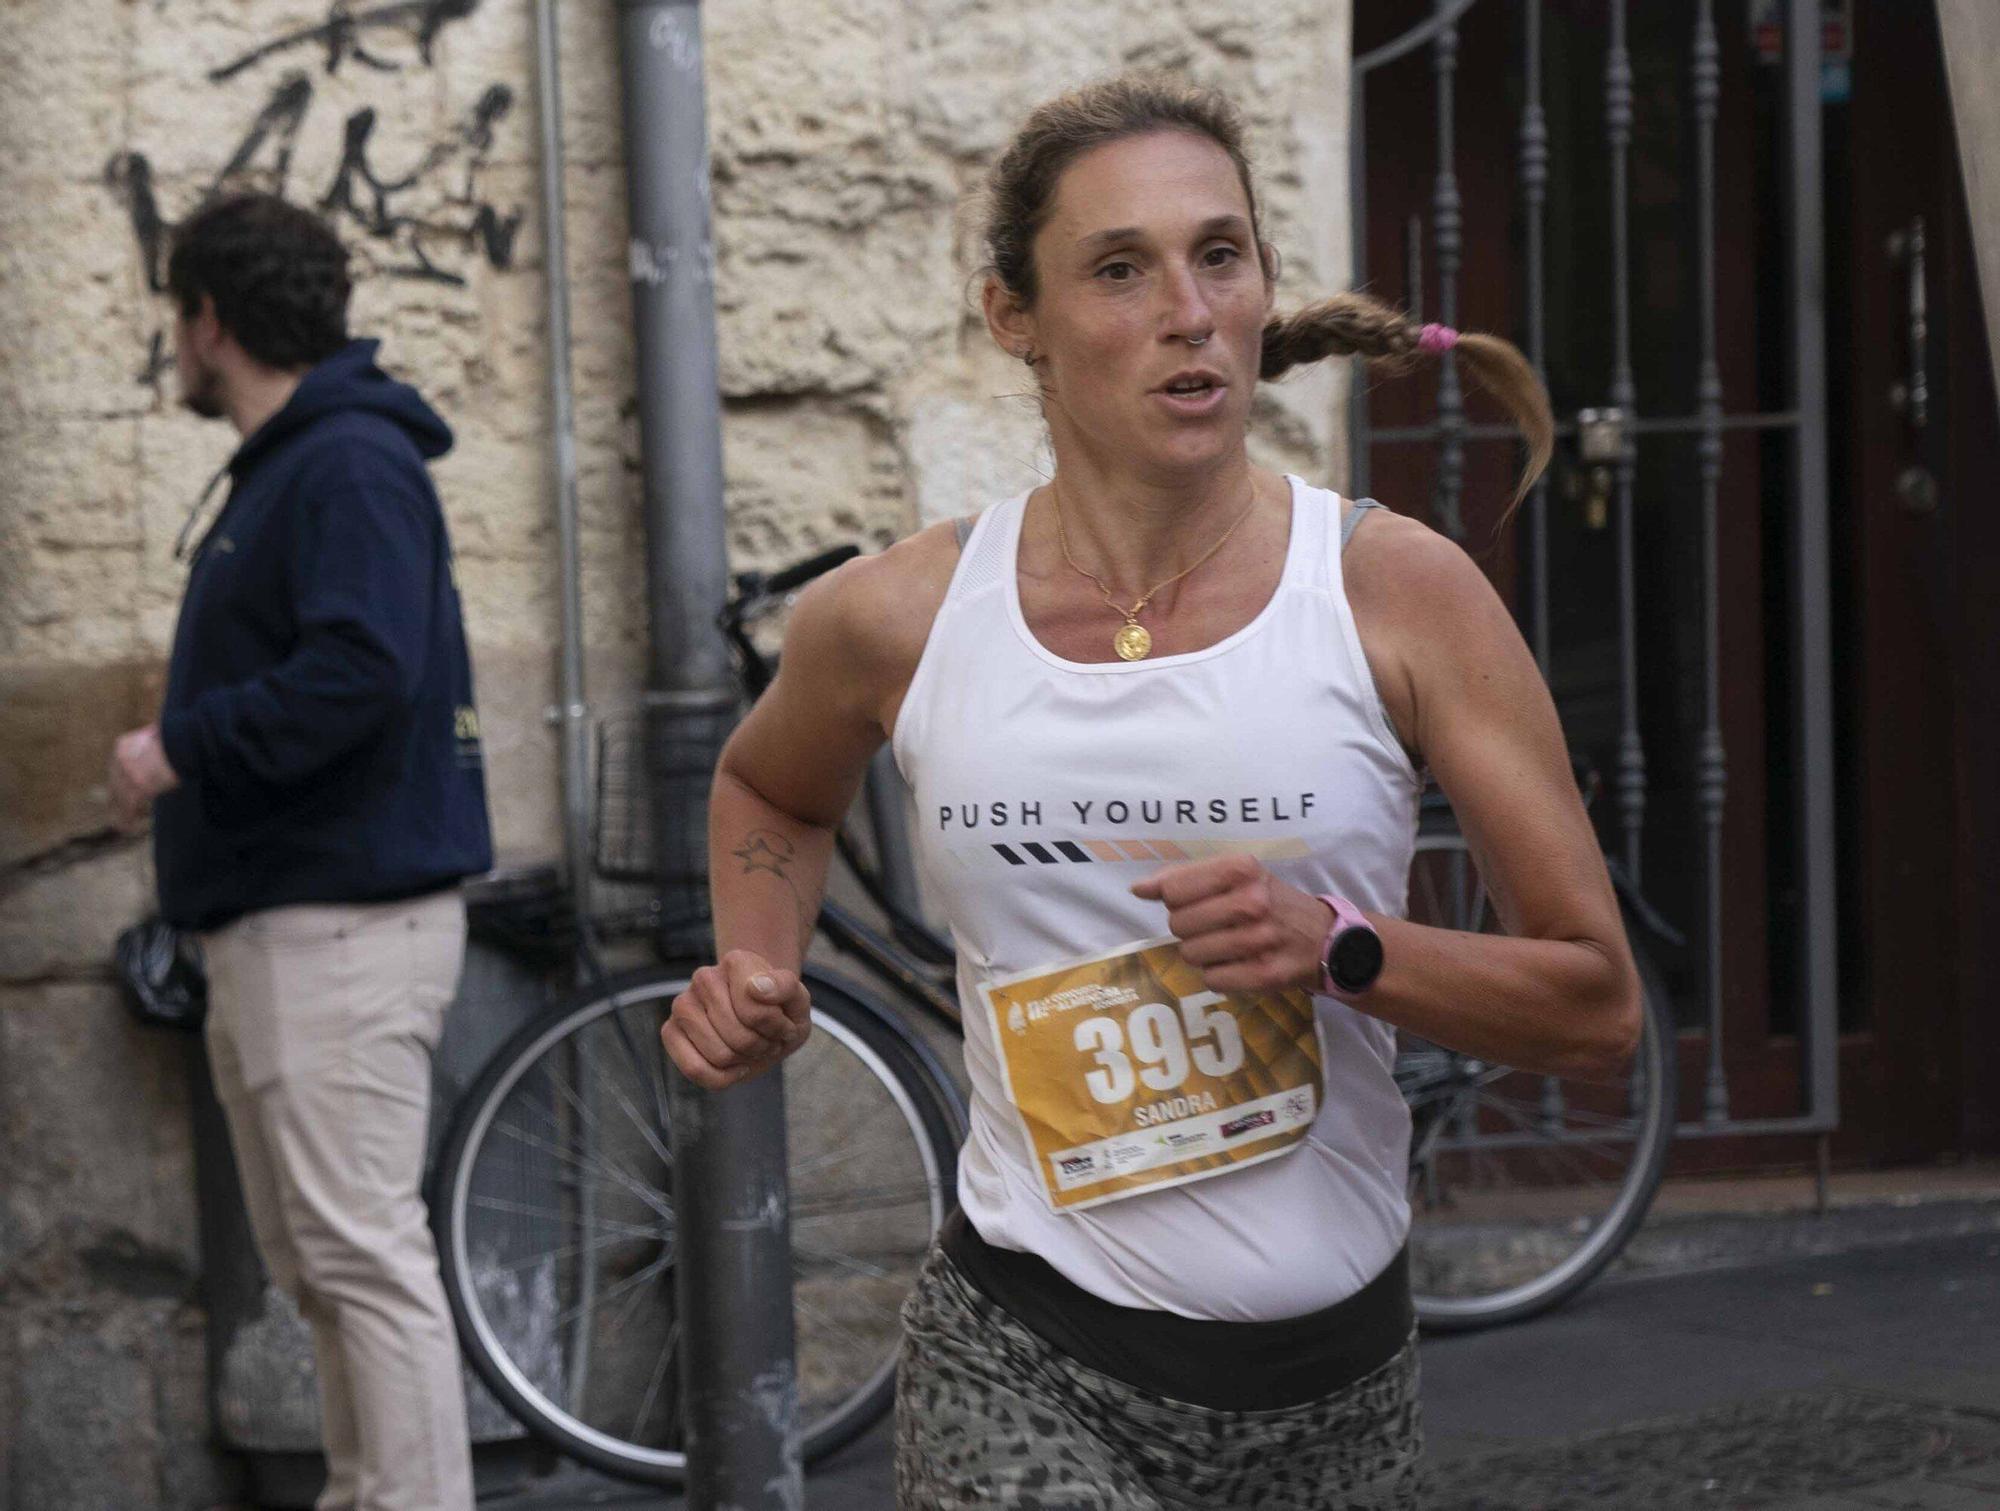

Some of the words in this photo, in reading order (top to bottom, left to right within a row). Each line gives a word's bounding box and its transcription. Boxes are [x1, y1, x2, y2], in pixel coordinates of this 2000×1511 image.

[940, 801, 1042, 831] PUSH
[1072, 792, 1316, 825] YOURSELF
[1073, 990, 1246, 1105] 395
[1133, 1091, 1218, 1128] SANDRA
